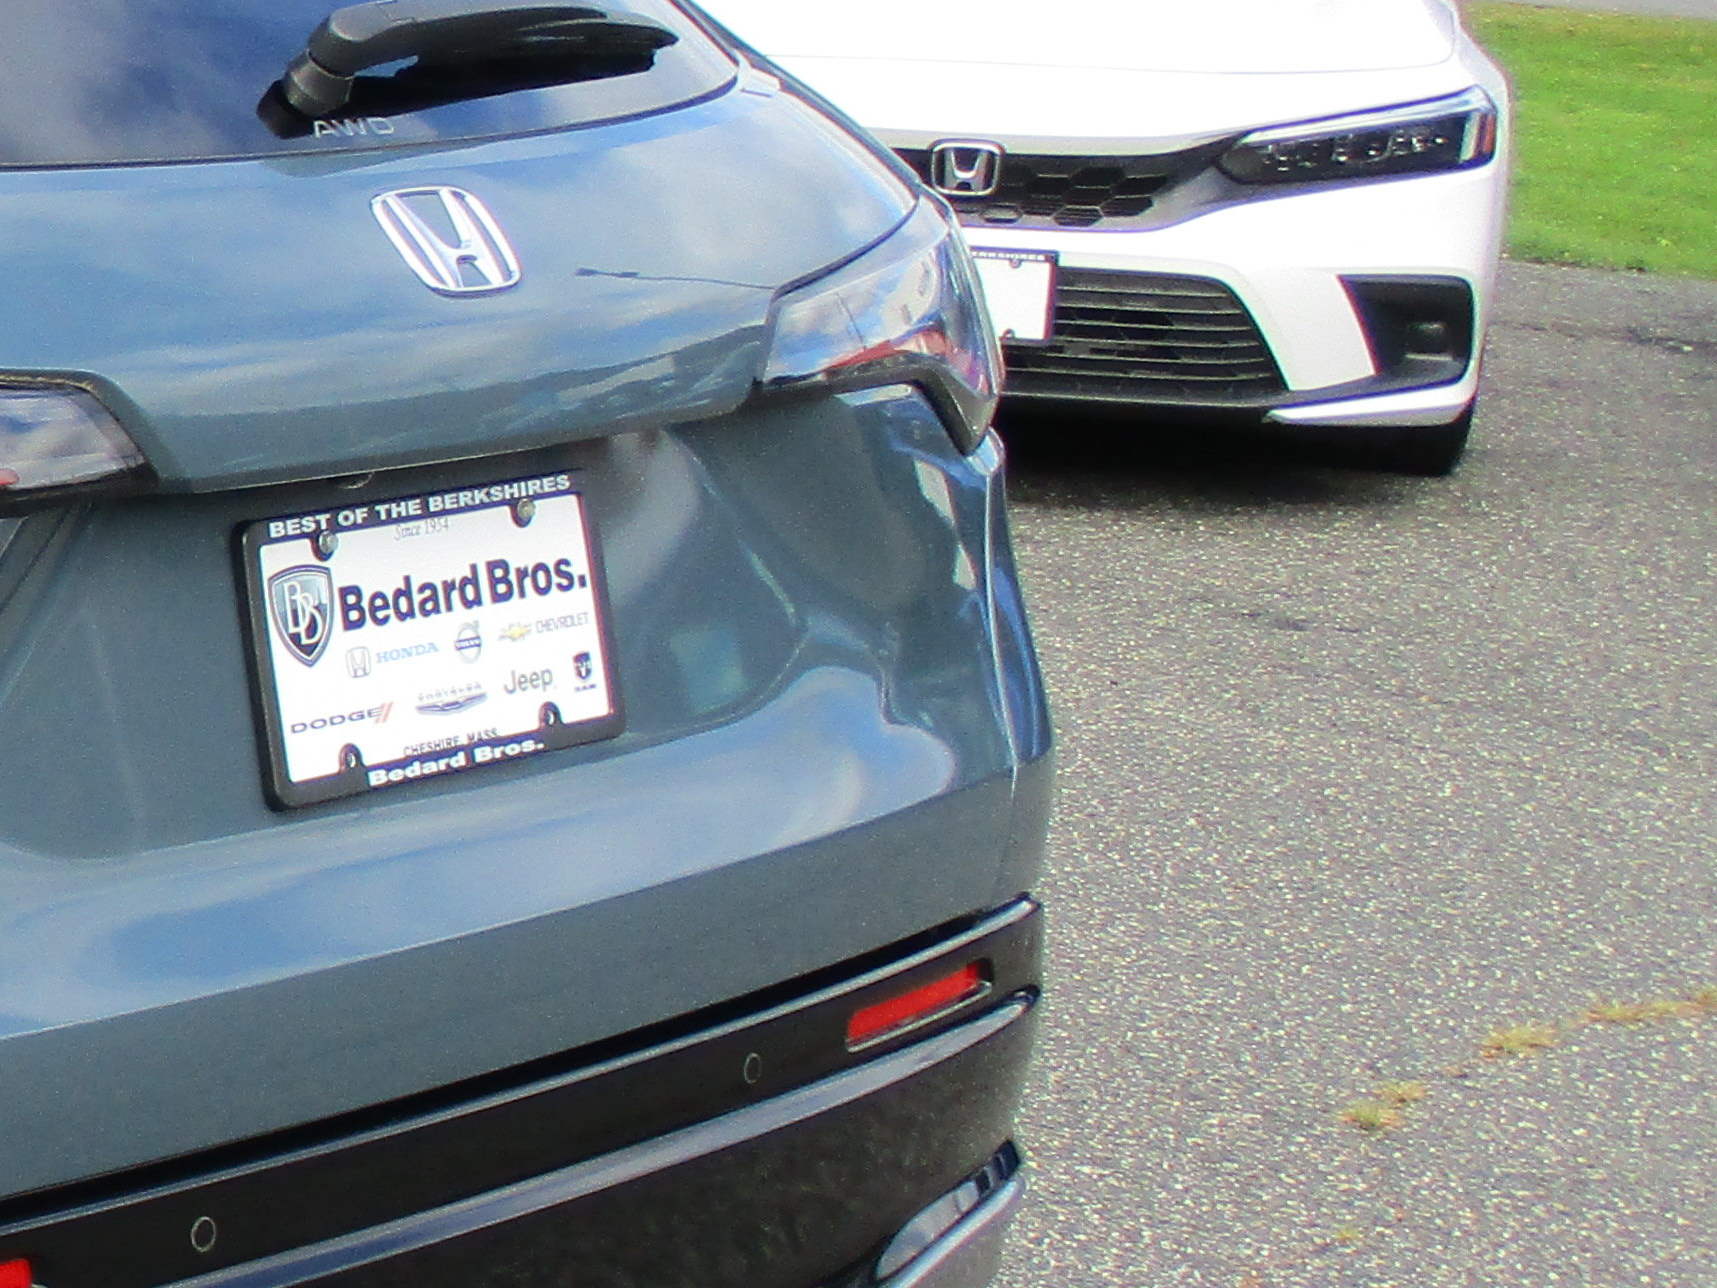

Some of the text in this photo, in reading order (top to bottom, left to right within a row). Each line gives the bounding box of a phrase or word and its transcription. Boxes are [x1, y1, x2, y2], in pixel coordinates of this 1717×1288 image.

[313, 116, 395, 138] AWD
[268, 474, 571, 539] BEST OF THE BERKSHIRES
[535, 612, 589, 634] CHEVROLET
[375, 641, 440, 664] HONDA
[503, 668, 554, 695] Jeep
[290, 706, 384, 734] DODGE
[367, 739, 545, 787] Bedard Bros.
